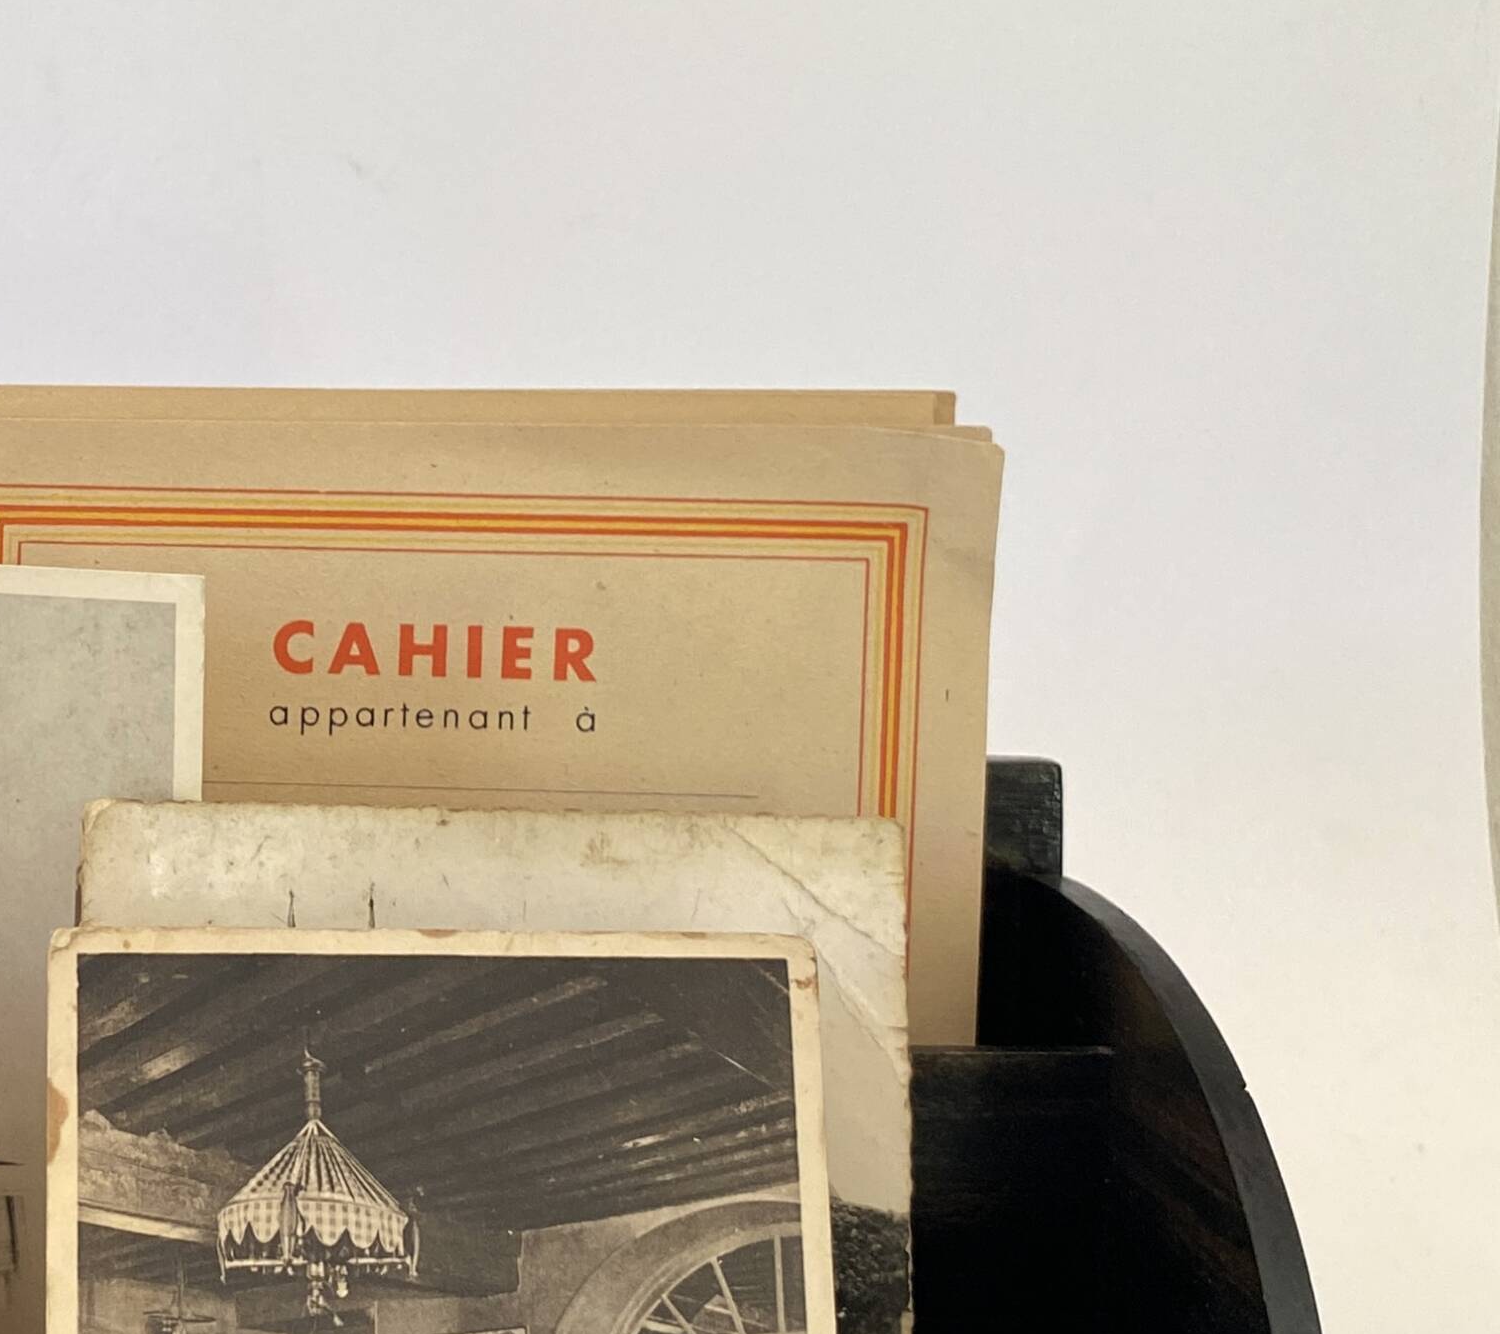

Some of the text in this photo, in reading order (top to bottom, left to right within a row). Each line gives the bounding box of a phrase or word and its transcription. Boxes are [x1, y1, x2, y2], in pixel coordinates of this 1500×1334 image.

[273, 620, 597, 682] CAHIER
[269, 703, 597, 736] appartenant à
